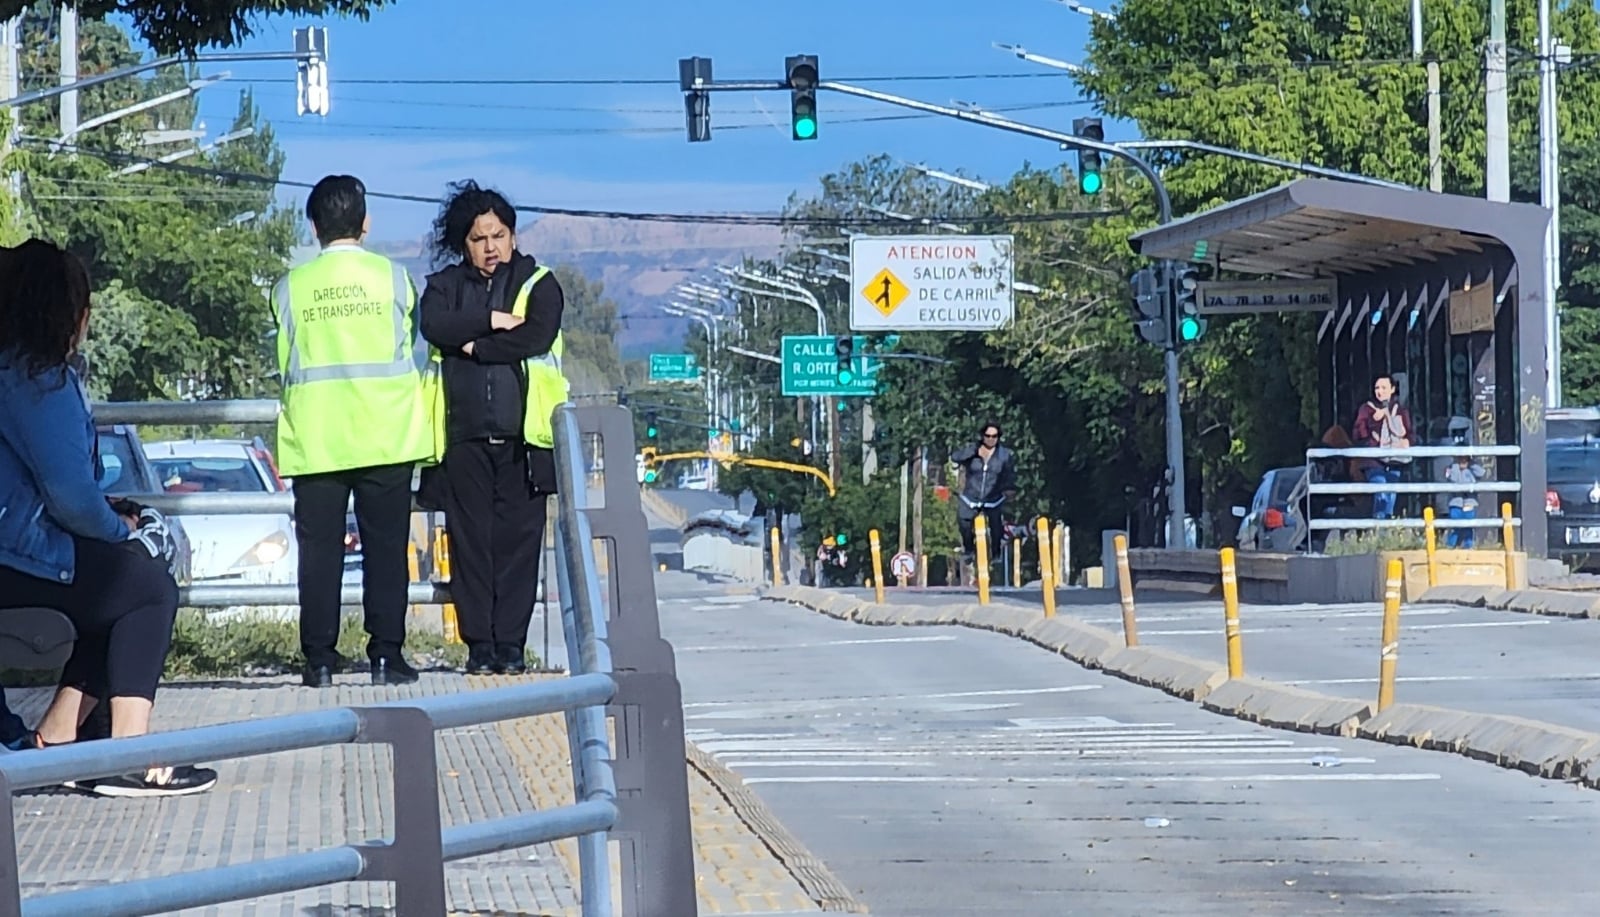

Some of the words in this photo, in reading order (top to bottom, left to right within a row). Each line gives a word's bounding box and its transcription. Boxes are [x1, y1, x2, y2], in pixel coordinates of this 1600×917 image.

[887, 246, 977, 260] ATENCION
[913, 267, 967, 280] SALIDA
[973, 266, 1003, 280] BUS
[919, 288, 938, 301] DE
[943, 287, 998, 301] CARRIL
[302, 308, 316, 322] DE
[317, 302, 382, 320] TRANSPORTE
[919, 308, 1001, 321] EXCLUSIVO
[793, 343, 835, 356] CALLE
[806, 360, 857, 375] ORTEA
